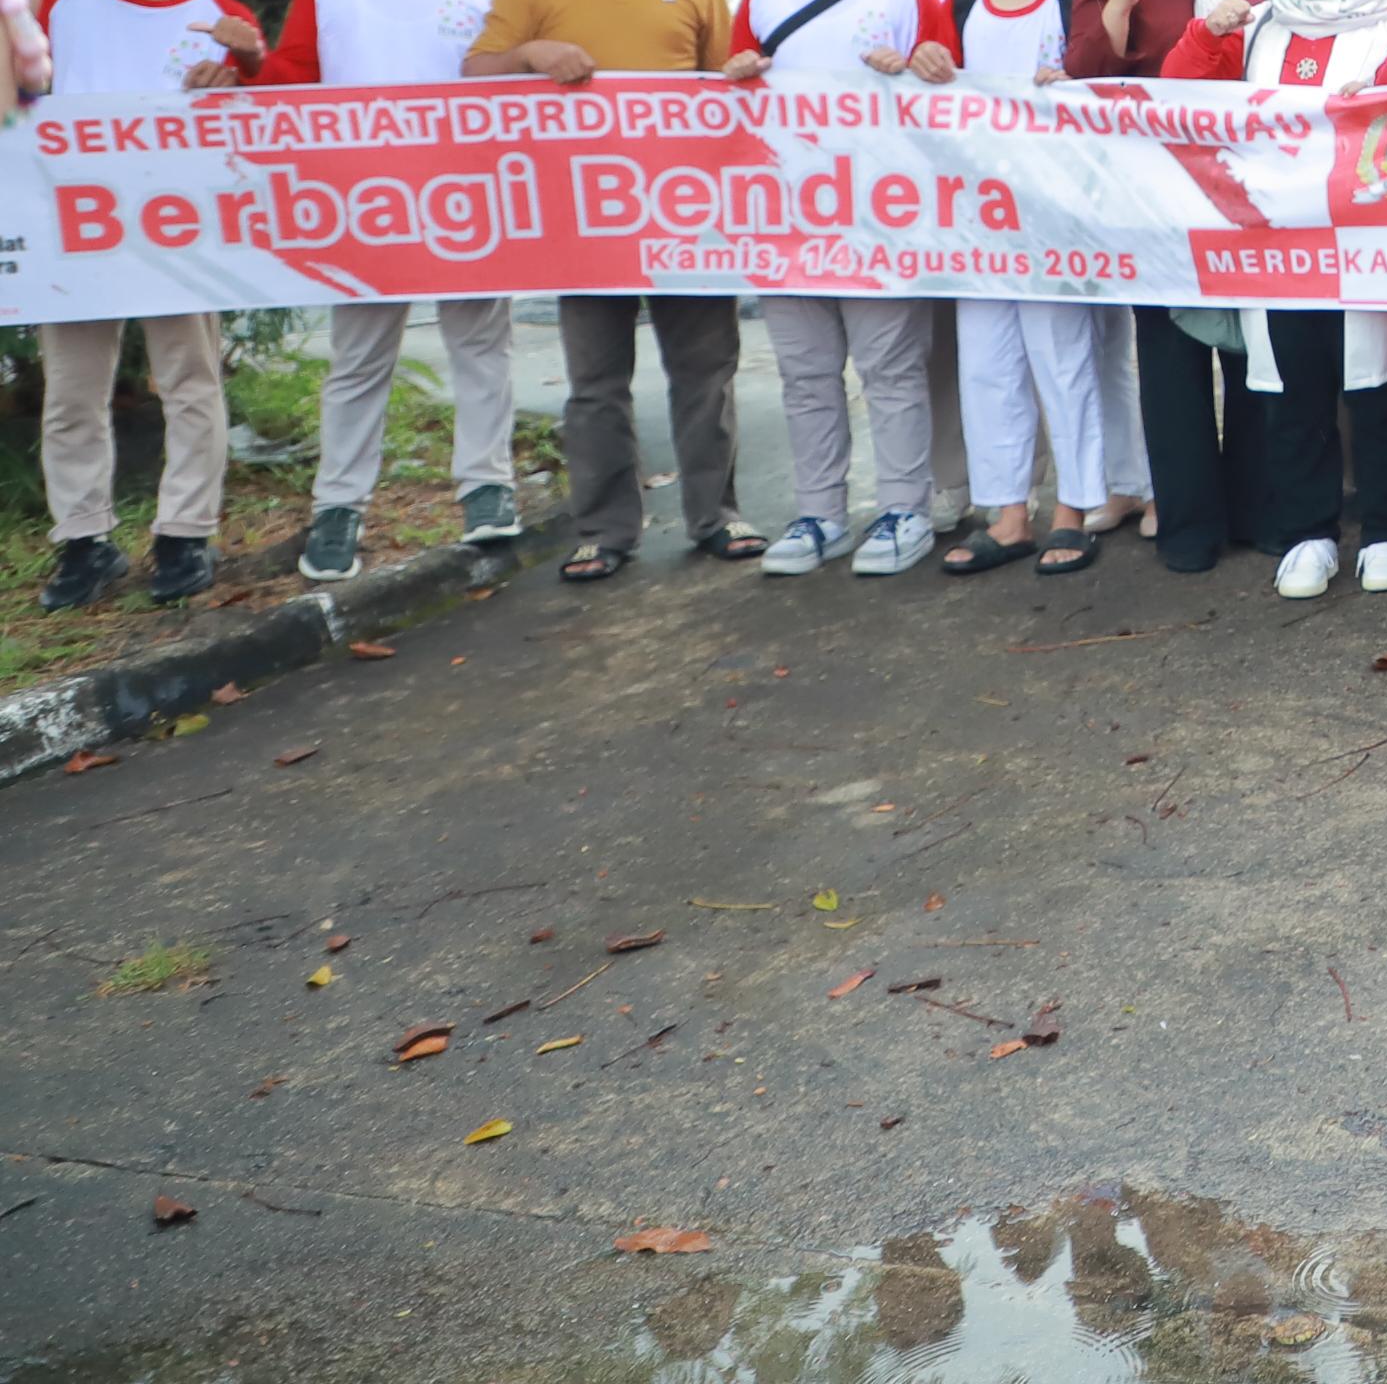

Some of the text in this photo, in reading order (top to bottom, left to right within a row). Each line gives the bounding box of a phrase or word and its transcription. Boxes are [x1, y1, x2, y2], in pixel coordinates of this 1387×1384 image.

[37, 90, 1312, 155] SEKRETARIAT DPRD PROVINSI KEPULAUAN RIAU
[55, 152, 1022, 258] Berbagi Bendera
[643, 238, 1138, 283] Kamis, 14 Agustus 2025
